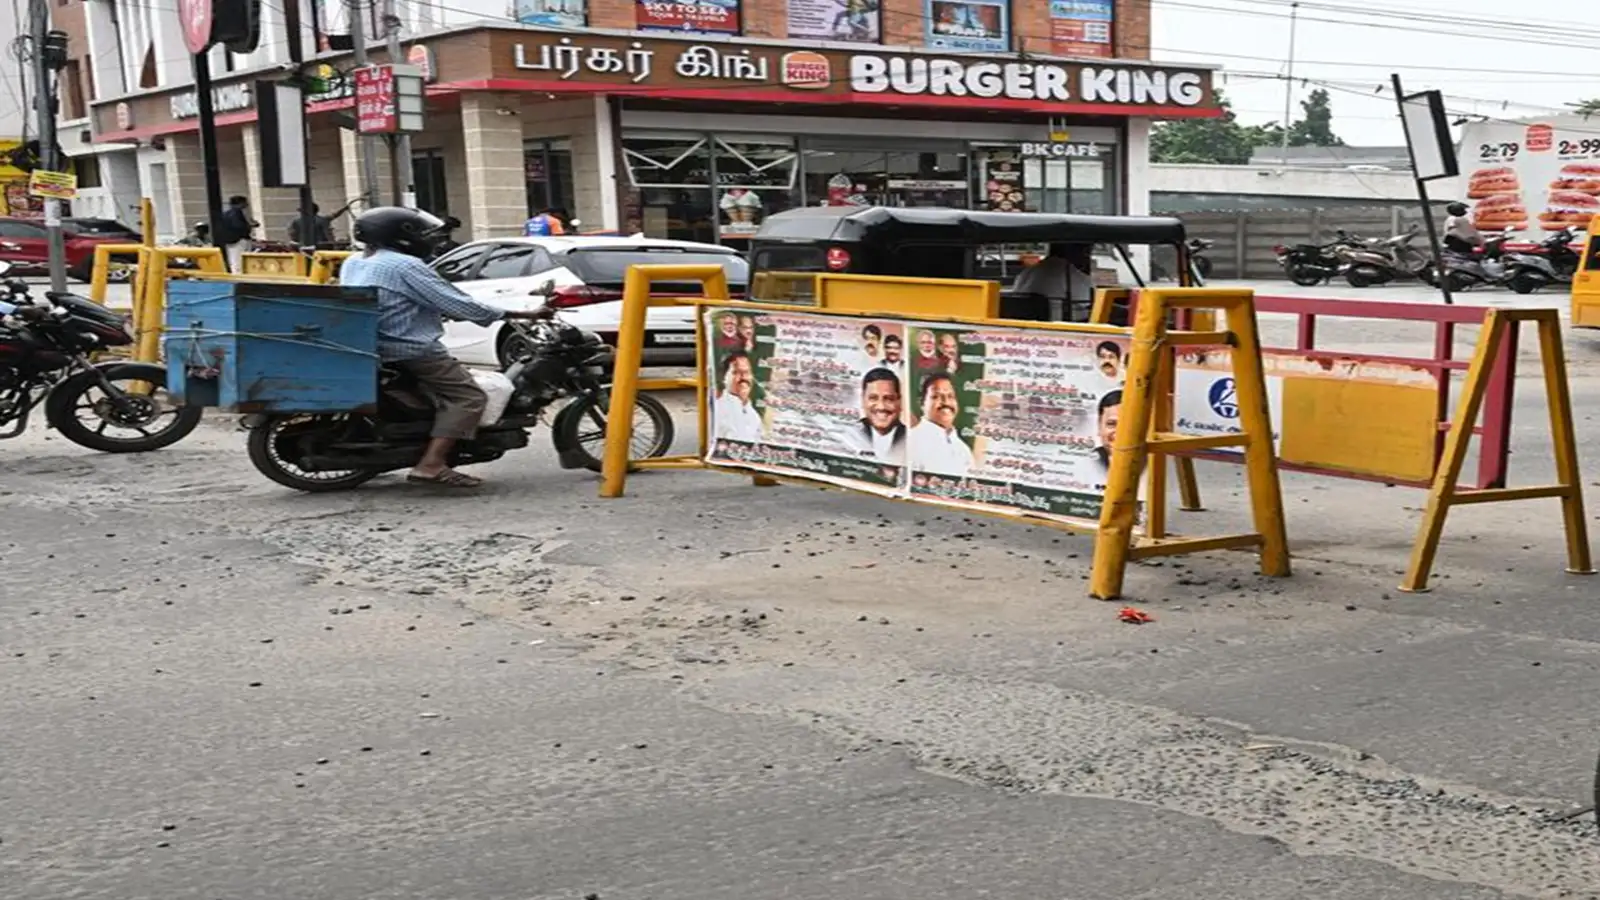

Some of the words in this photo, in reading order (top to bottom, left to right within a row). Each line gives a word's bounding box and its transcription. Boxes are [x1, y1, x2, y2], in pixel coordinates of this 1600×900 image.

[677, 4, 695, 14] TO
[697, 6, 729, 17] SEA
[514, 38, 654, 83] பர்கர்
[676, 45, 768, 81] கிங்
[787, 62, 827, 71] BURGER
[787, 70, 828, 82] KING
[850, 54, 1069, 102] BURGER
[1081, 67, 1203, 106] KING
[1021, 142, 1049, 156] BK
[1052, 141, 1099, 157] CAFÉ
